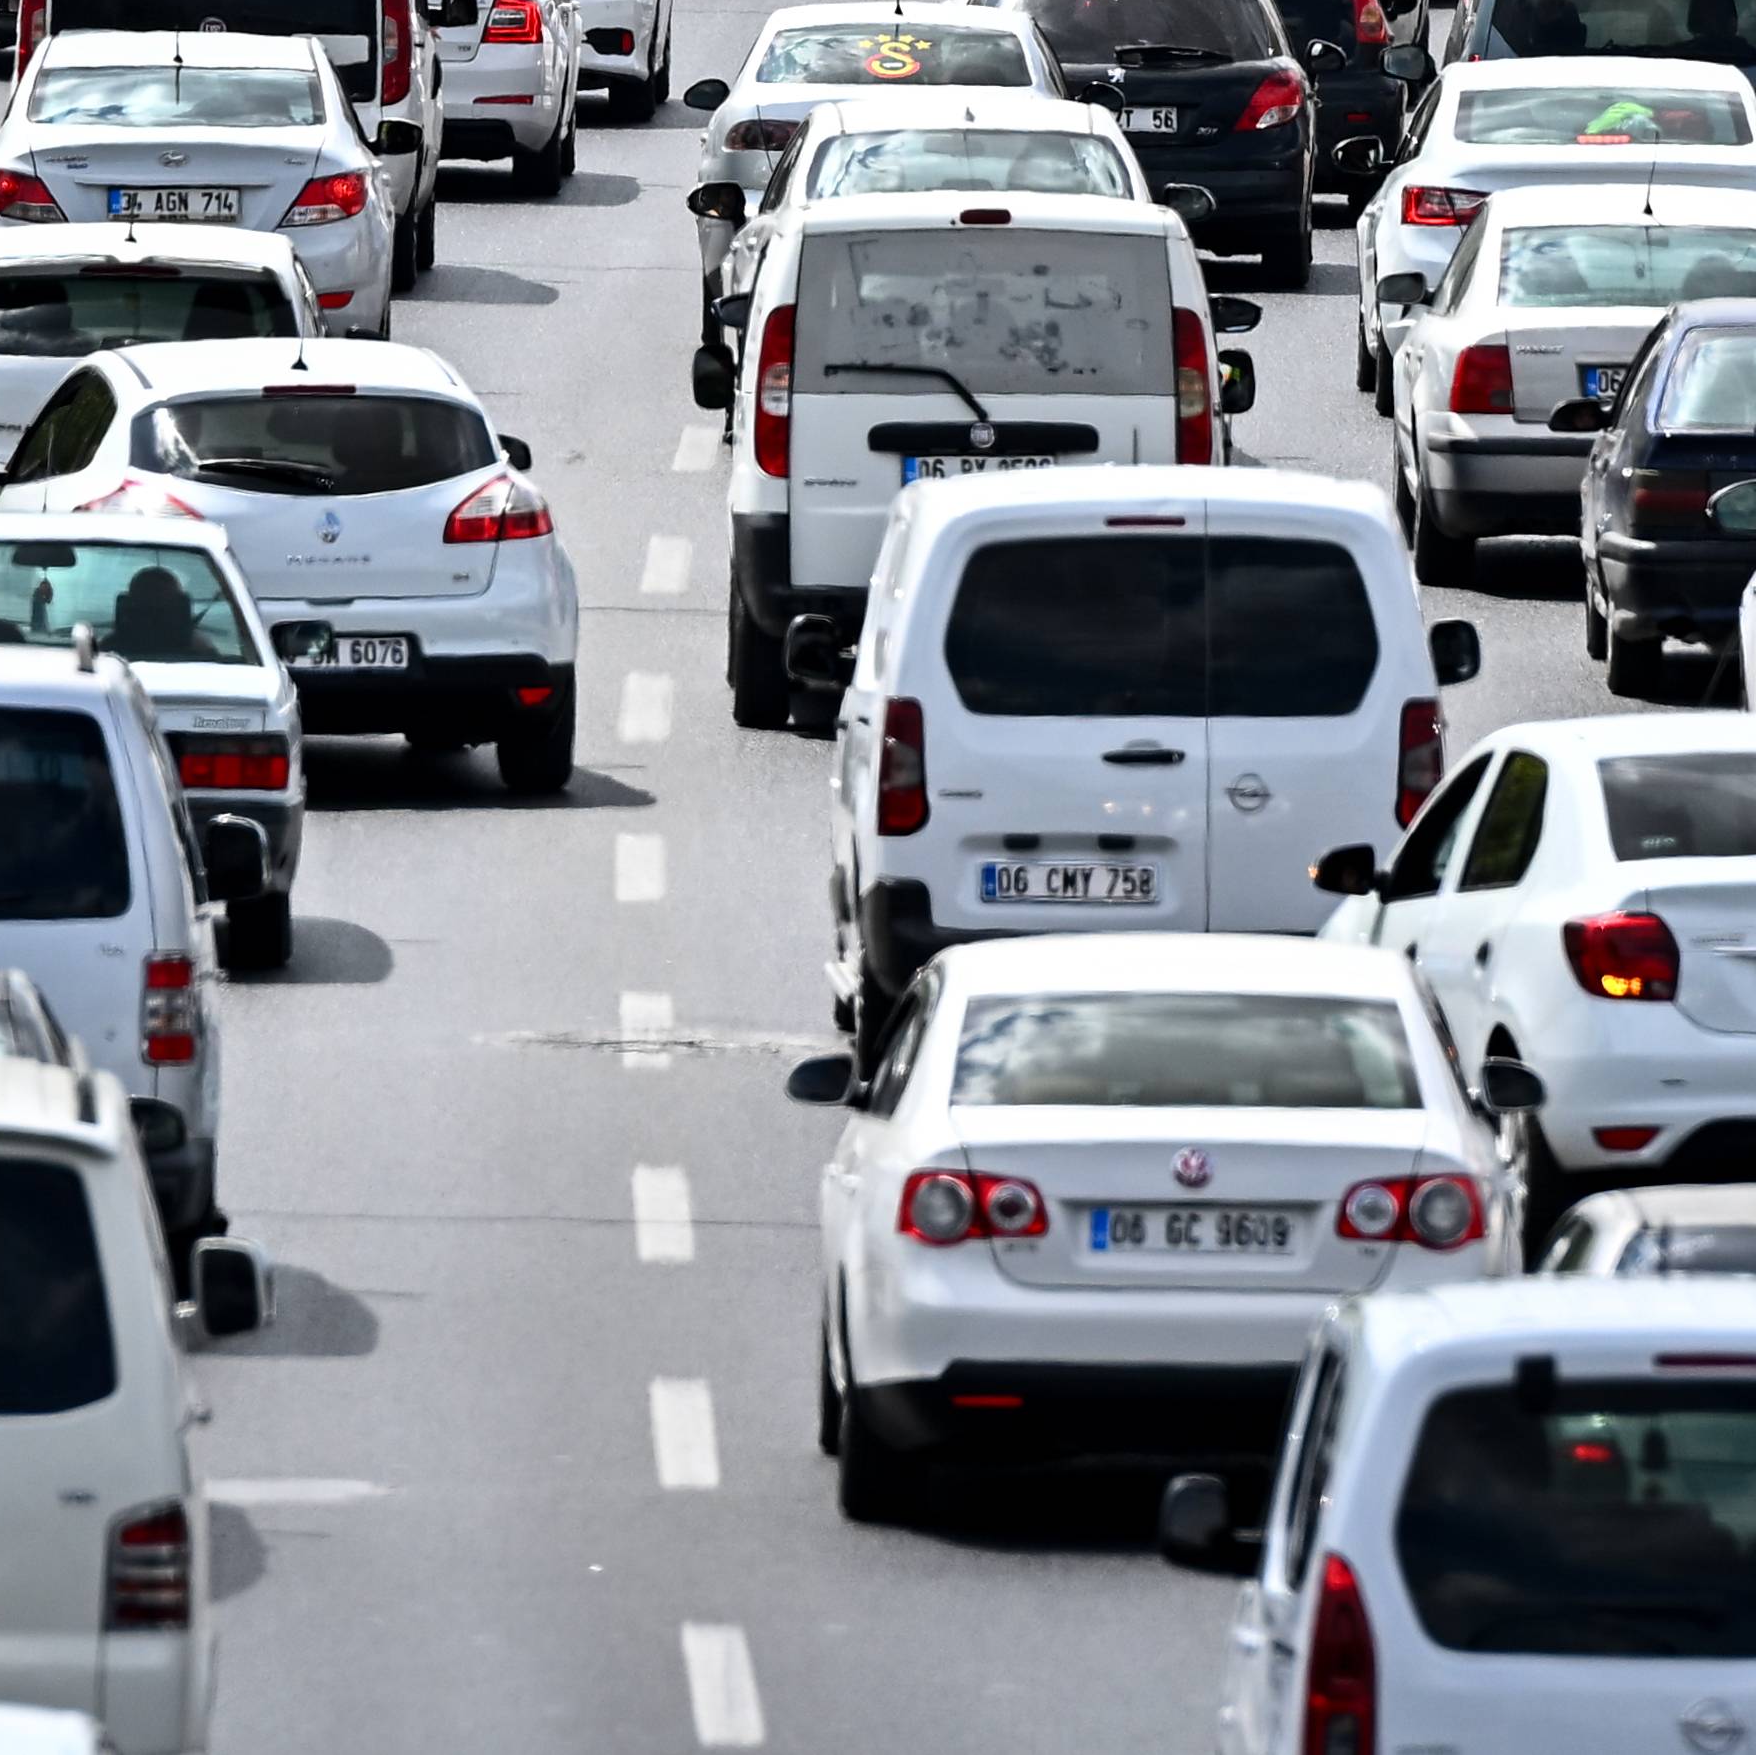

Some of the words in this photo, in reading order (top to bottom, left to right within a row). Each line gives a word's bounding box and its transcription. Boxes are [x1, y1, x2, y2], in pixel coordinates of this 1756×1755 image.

[1152, 110, 1174, 129] 56
[154, 192, 191, 214] AGN
[202, 193, 235, 215] 714
[1597, 369, 1621, 394] 06
[349, 637, 406, 665] 6076
[996, 866, 1028, 894] 06
[1045, 866, 1091, 895] CMY
[1106, 866, 1156, 897] 758
[1109, 1211, 1147, 1245] 06
[1164, 1211, 1201, 1245] GC
